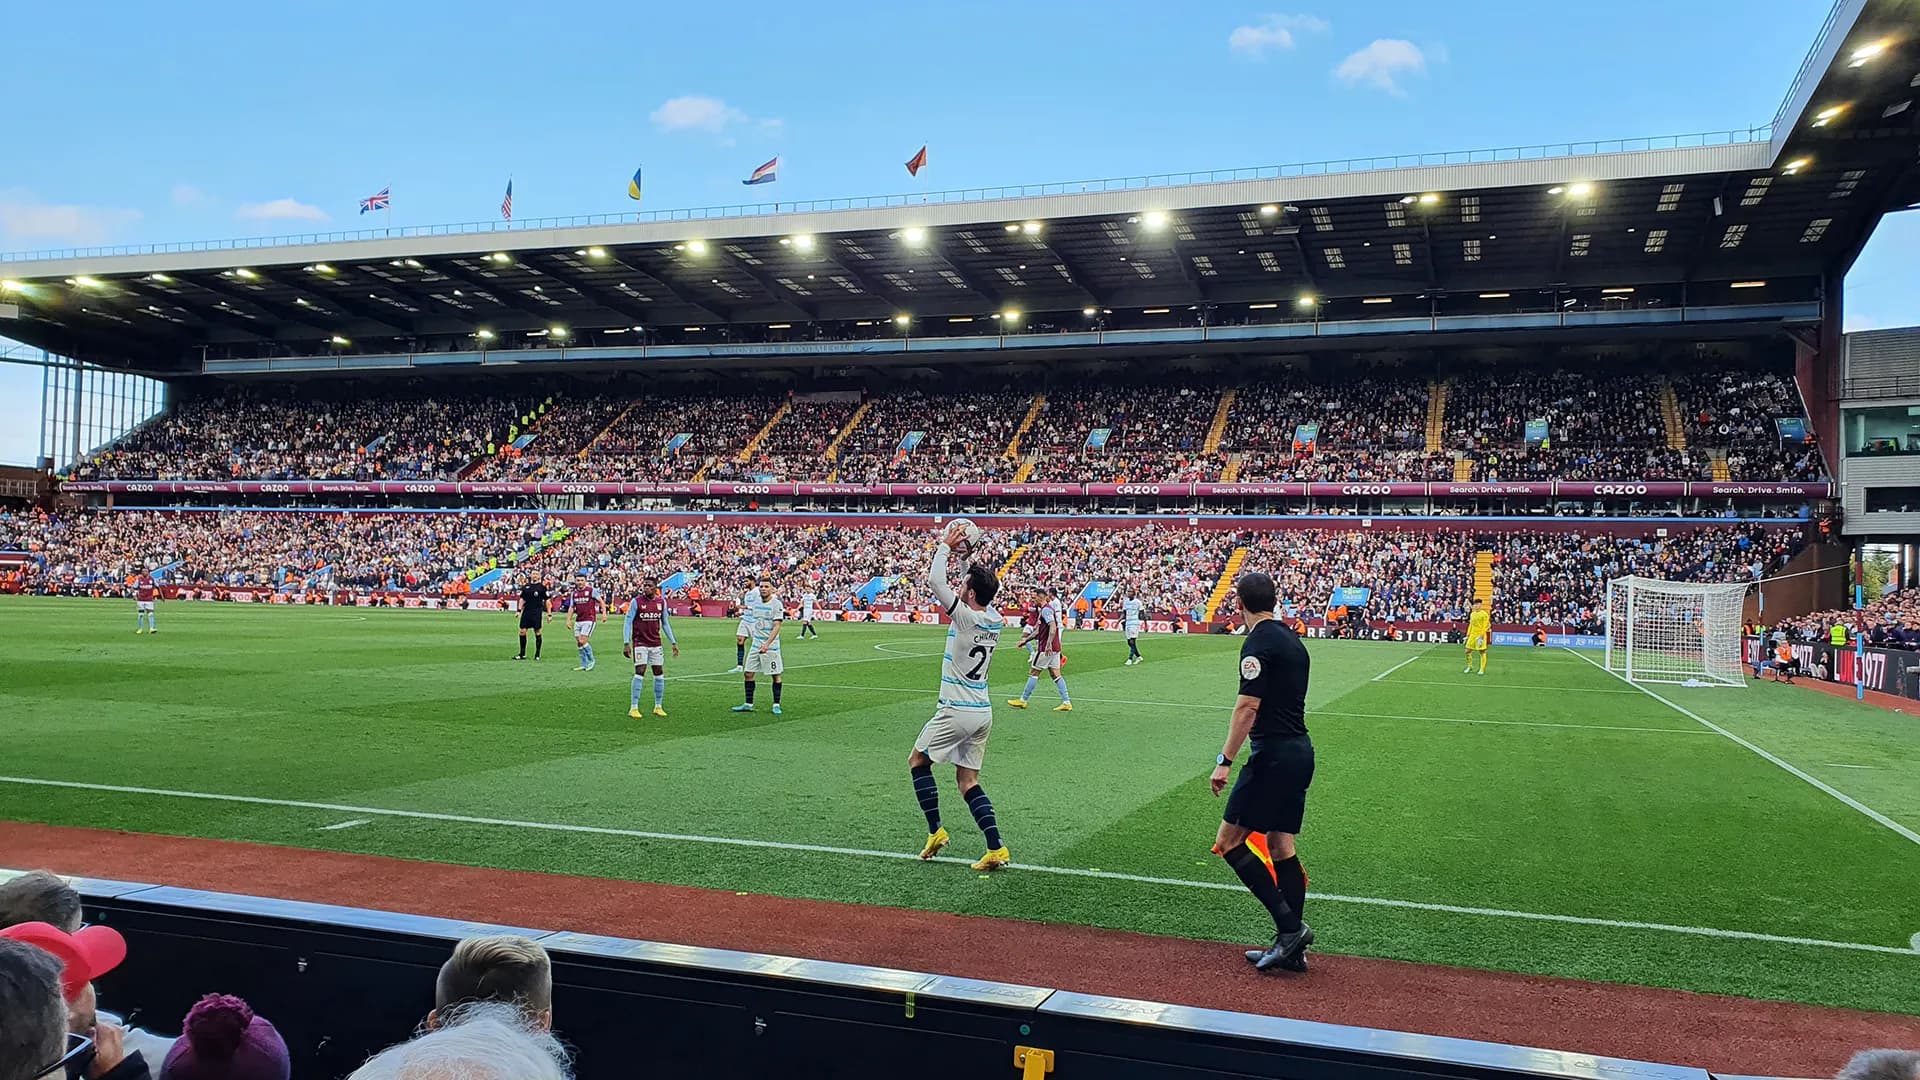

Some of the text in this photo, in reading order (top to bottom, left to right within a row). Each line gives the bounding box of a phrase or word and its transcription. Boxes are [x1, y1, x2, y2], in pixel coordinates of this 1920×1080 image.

[126, 484, 154, 492] CAZOO
[260, 484, 289, 493] CAZOO
[404, 484, 436, 493] CAZOO
[562, 484, 596, 494] CAZOO
[733, 485, 770, 494] CAZOO
[916, 486, 957, 495] CAZOO
[1116, 485, 1160, 495] CAZOO
[1342, 485, 1391, 495] CAZOO
[1449, 486, 1532, 494] Search. Drive. Smile.
[1593, 485, 1648, 495] CAZOO
[1713, 486, 1805, 494] Search. Drive. Smile.
[770, 661, 777, 670] 8
